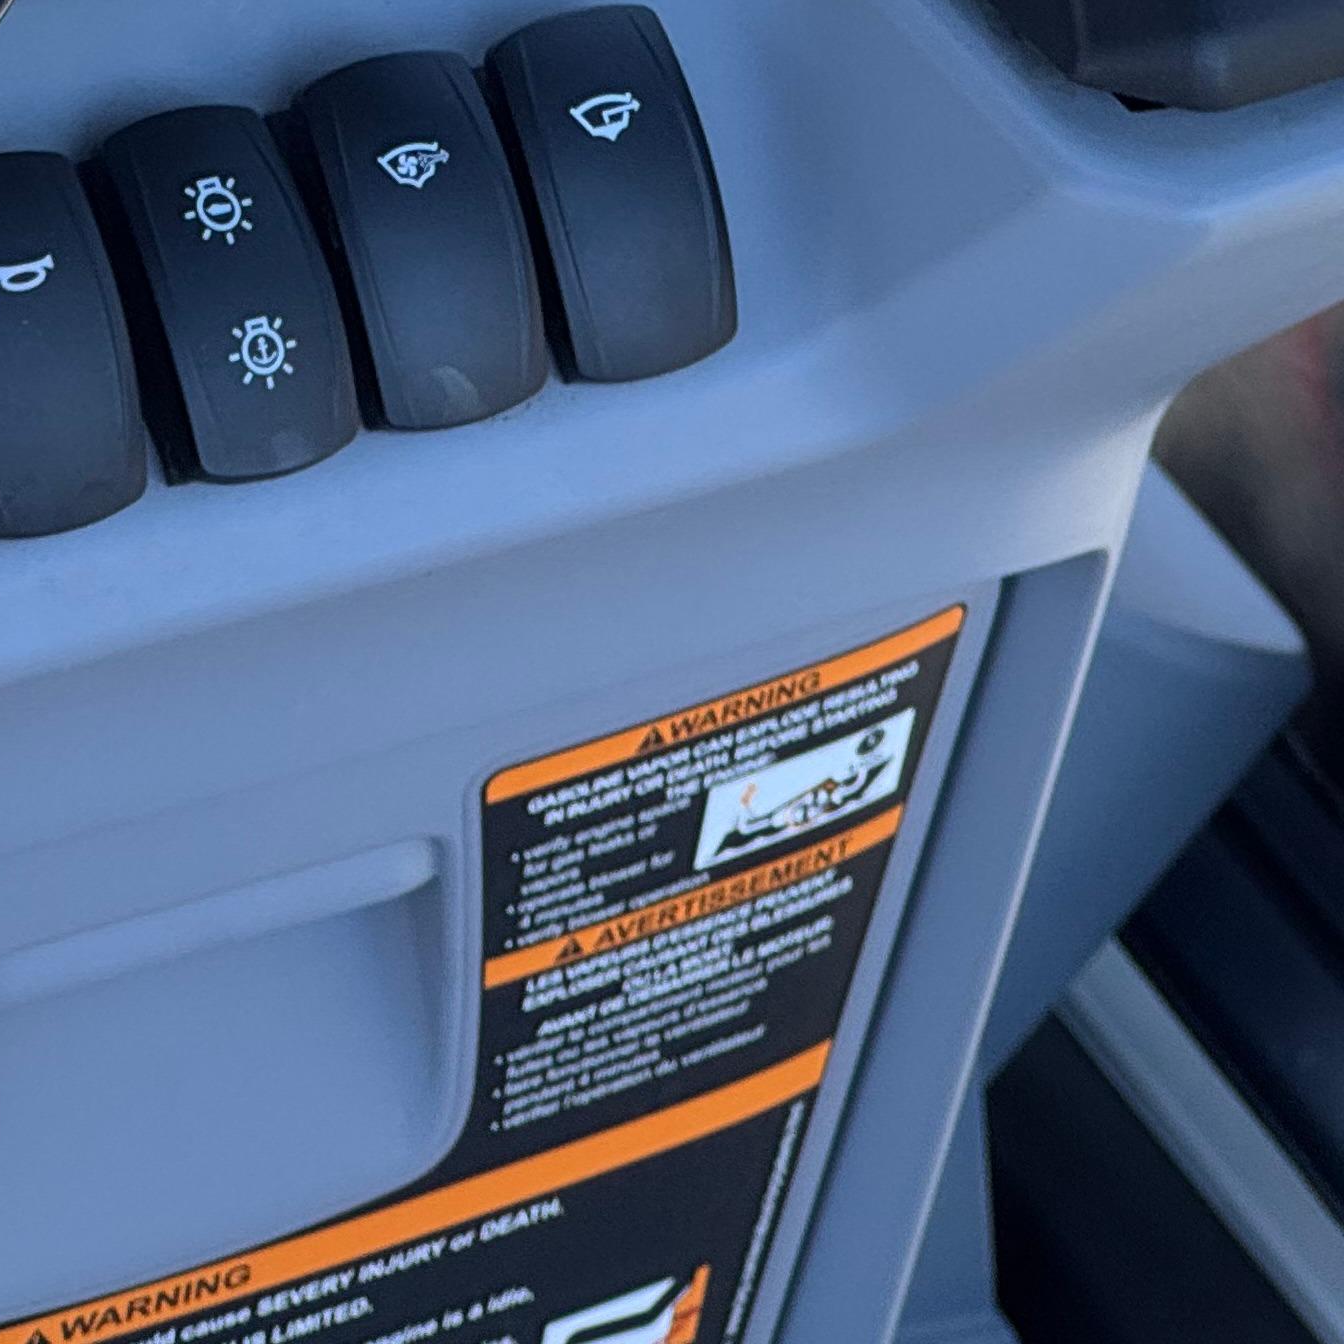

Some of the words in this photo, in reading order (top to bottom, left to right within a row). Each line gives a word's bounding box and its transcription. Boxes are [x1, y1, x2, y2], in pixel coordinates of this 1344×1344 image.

[670, 669, 821, 739] WARNING
[593, 837, 851, 952] AVERTISSEMENT
[60, 1263, 252, 1341] WARNING
